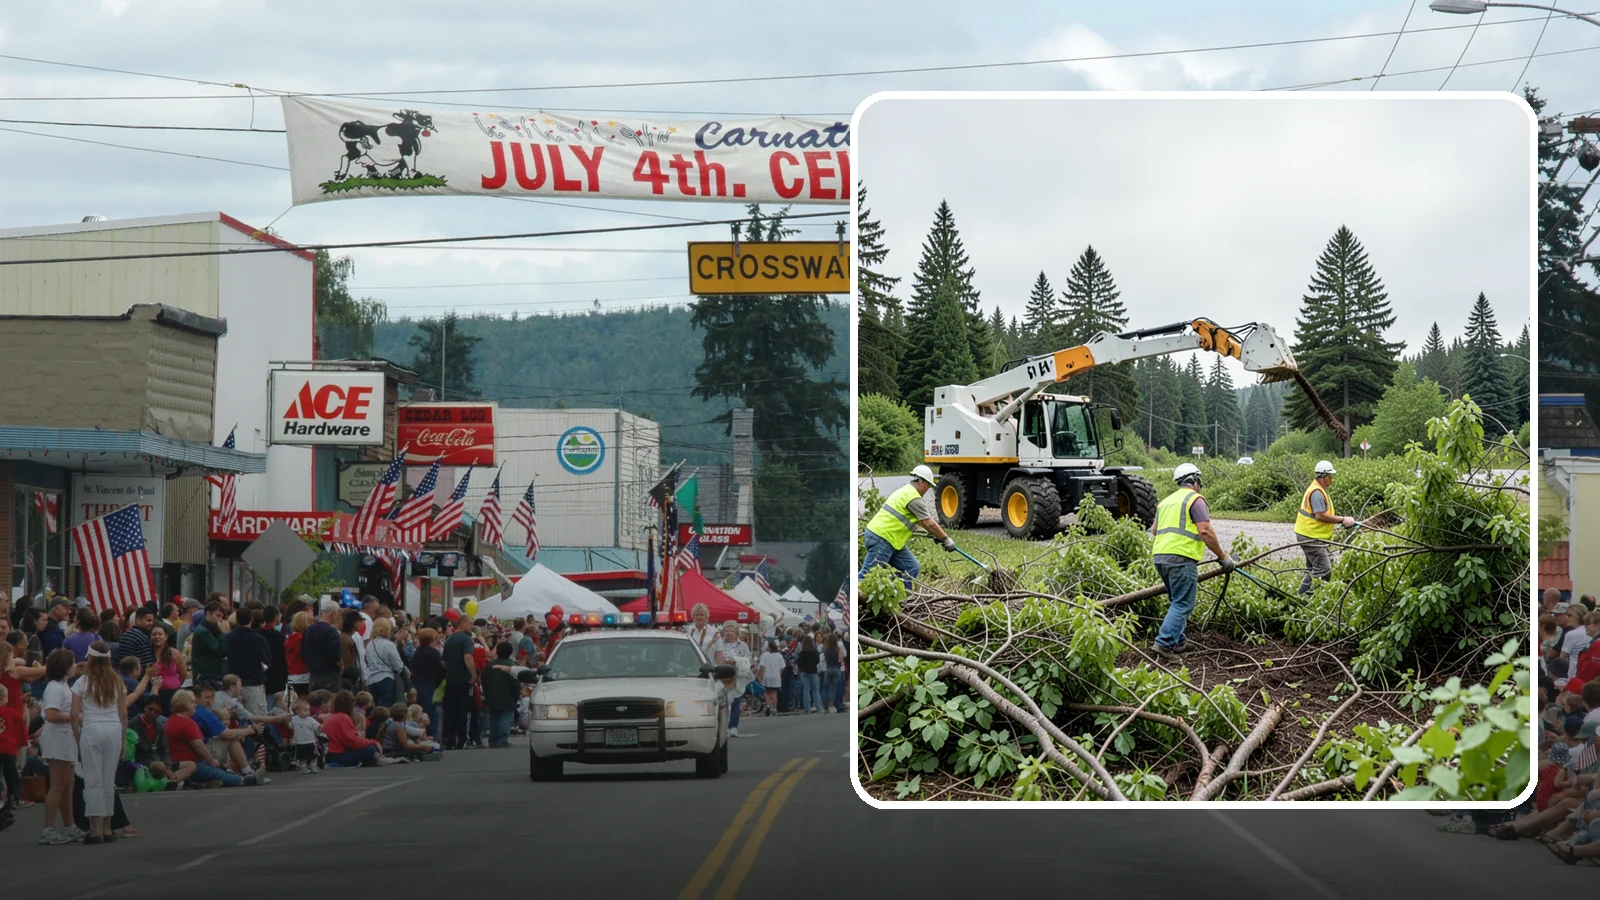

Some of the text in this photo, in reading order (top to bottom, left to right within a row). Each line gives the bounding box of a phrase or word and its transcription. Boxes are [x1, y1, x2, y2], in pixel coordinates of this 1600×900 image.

[695, 121, 850, 149] Carnat
[481, 141, 605, 192] JULY
[632, 150, 746, 198] 4th.
[697, 254, 850, 280] CROSSWA
[283, 380, 373, 420] ACE
[406, 409, 452, 422] CEDAR
[284, 421, 370, 436] Hardware
[353, 467, 385, 481] Simpl
[96, 485, 124, 495] Vincent
[126, 486, 135, 495] de
[138, 486, 155, 495] Paul
[212, 516, 330, 535] HARDARE
[688, 526, 741, 535] CRNATION
[700, 535, 730, 543] GLASS
